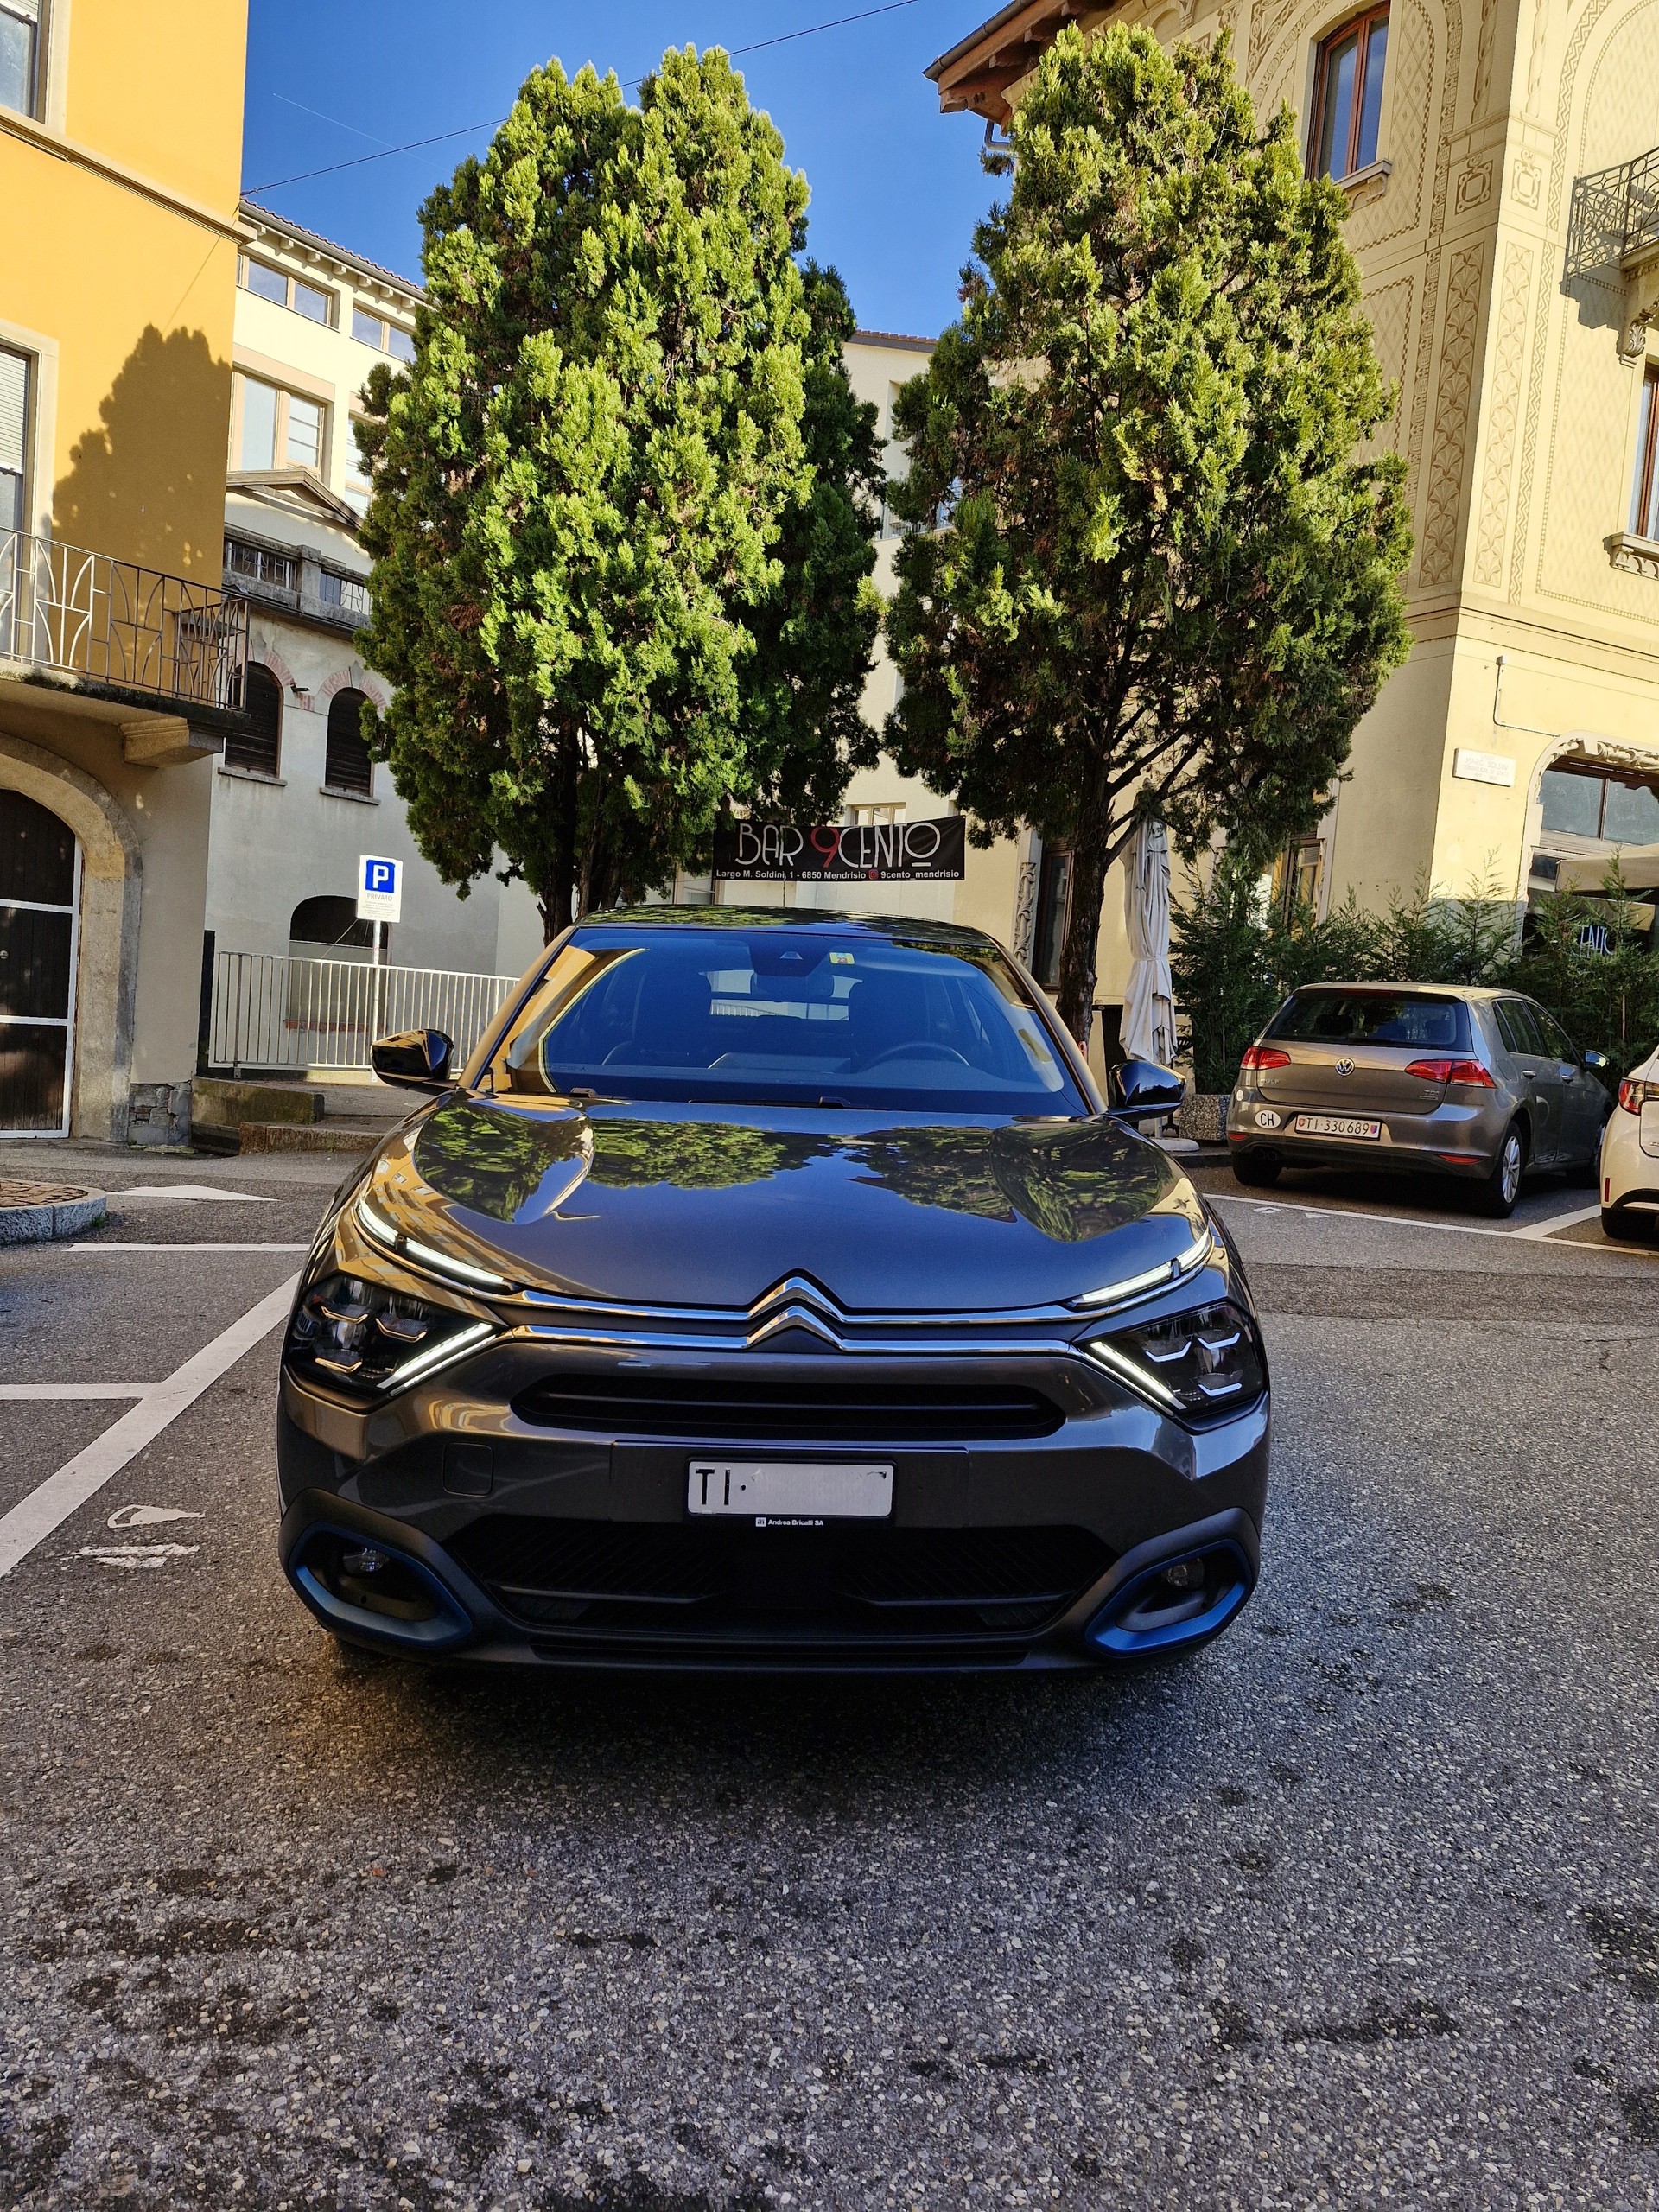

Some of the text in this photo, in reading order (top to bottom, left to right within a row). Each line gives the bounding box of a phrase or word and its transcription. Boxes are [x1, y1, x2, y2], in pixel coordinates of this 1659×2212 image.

[734, 822, 941, 868] BAR 9CENTO
[372, 864, 389, 889] P
[716, 869, 741, 879] Largo
[743, 869, 753, 878] M.
[823, 871, 867, 880] Mendrisio
[880, 870, 960, 880] 9cento_mendrisio
[366, 893, 393, 901] PRIVATO
[1260, 1113, 1274, 1126] CH
